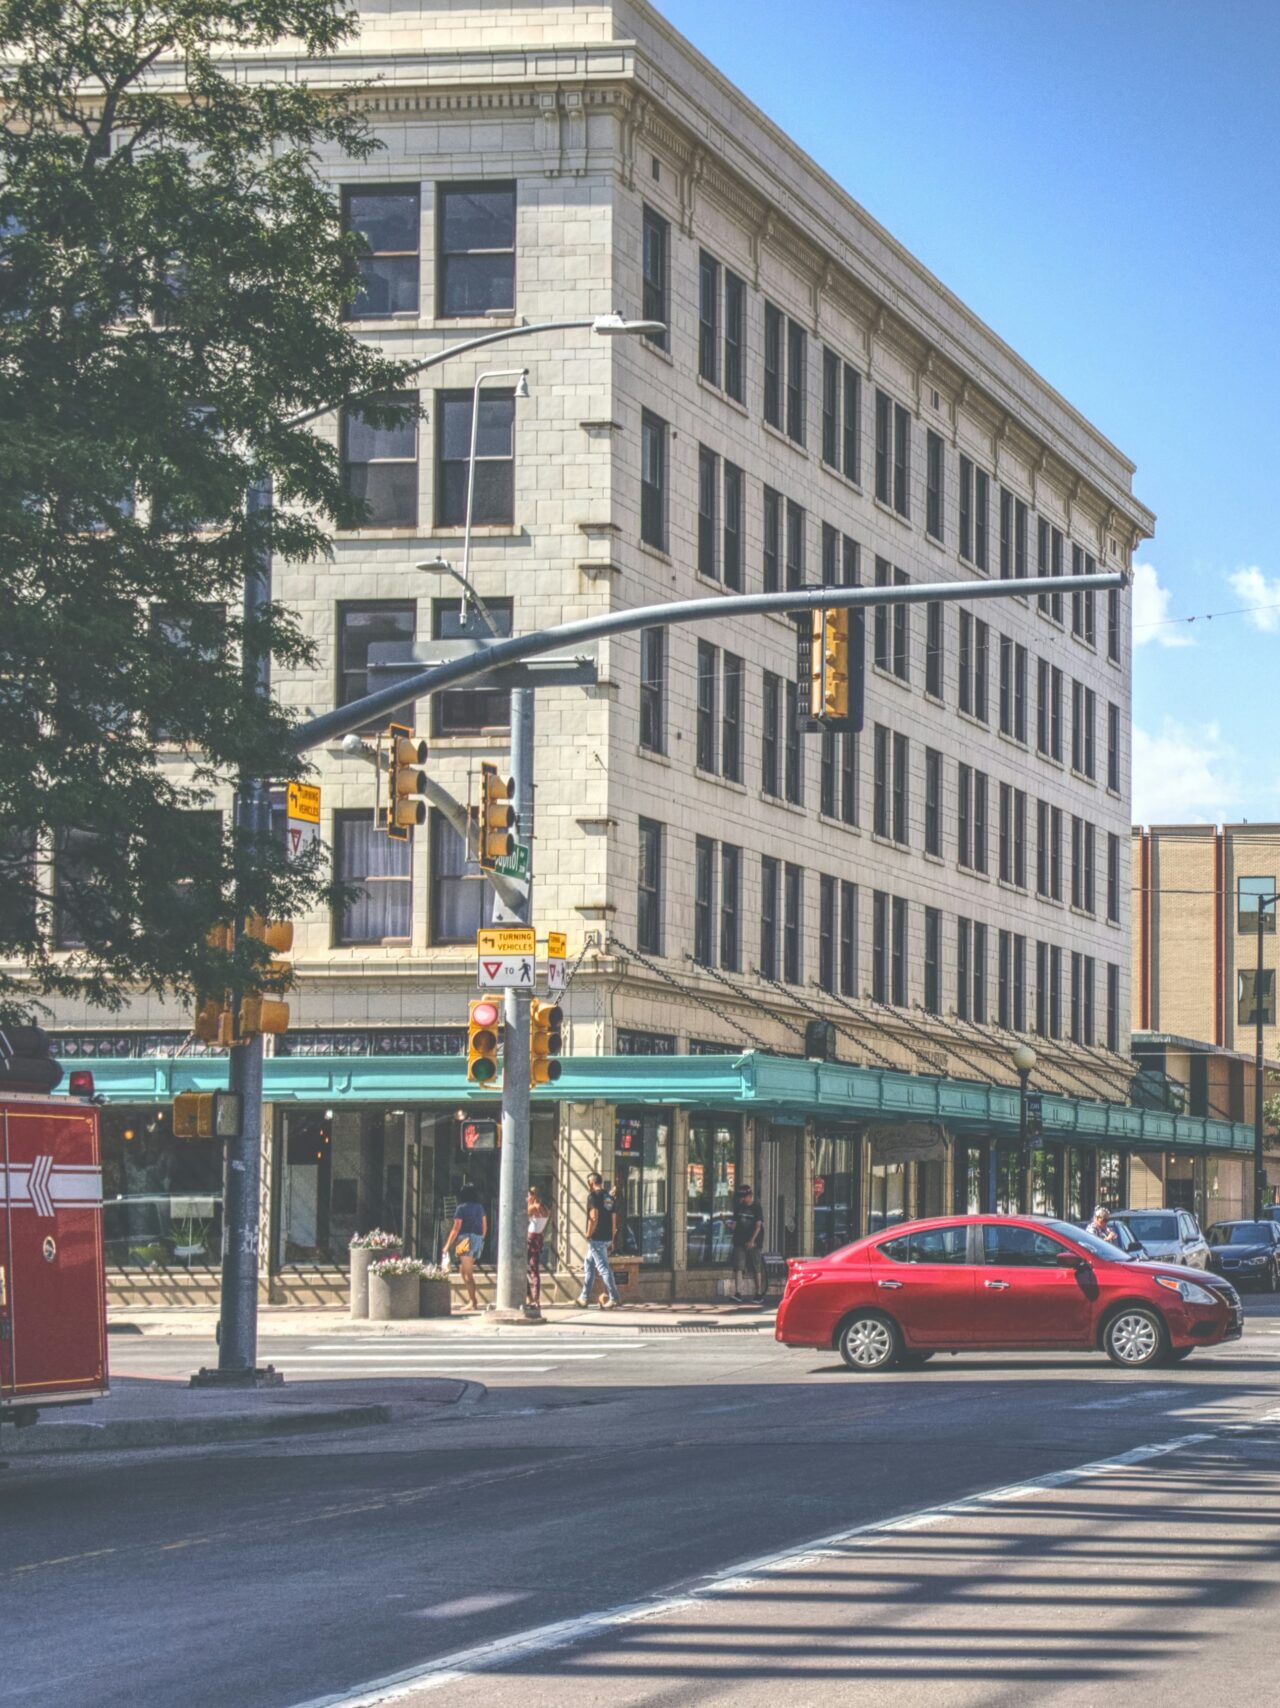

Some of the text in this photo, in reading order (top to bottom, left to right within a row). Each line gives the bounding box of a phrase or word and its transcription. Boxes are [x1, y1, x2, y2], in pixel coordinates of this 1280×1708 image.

[499, 933, 532, 941] TURNING
[498, 943, 533, 951] VEHICLES
[504, 967, 515, 975] TO
